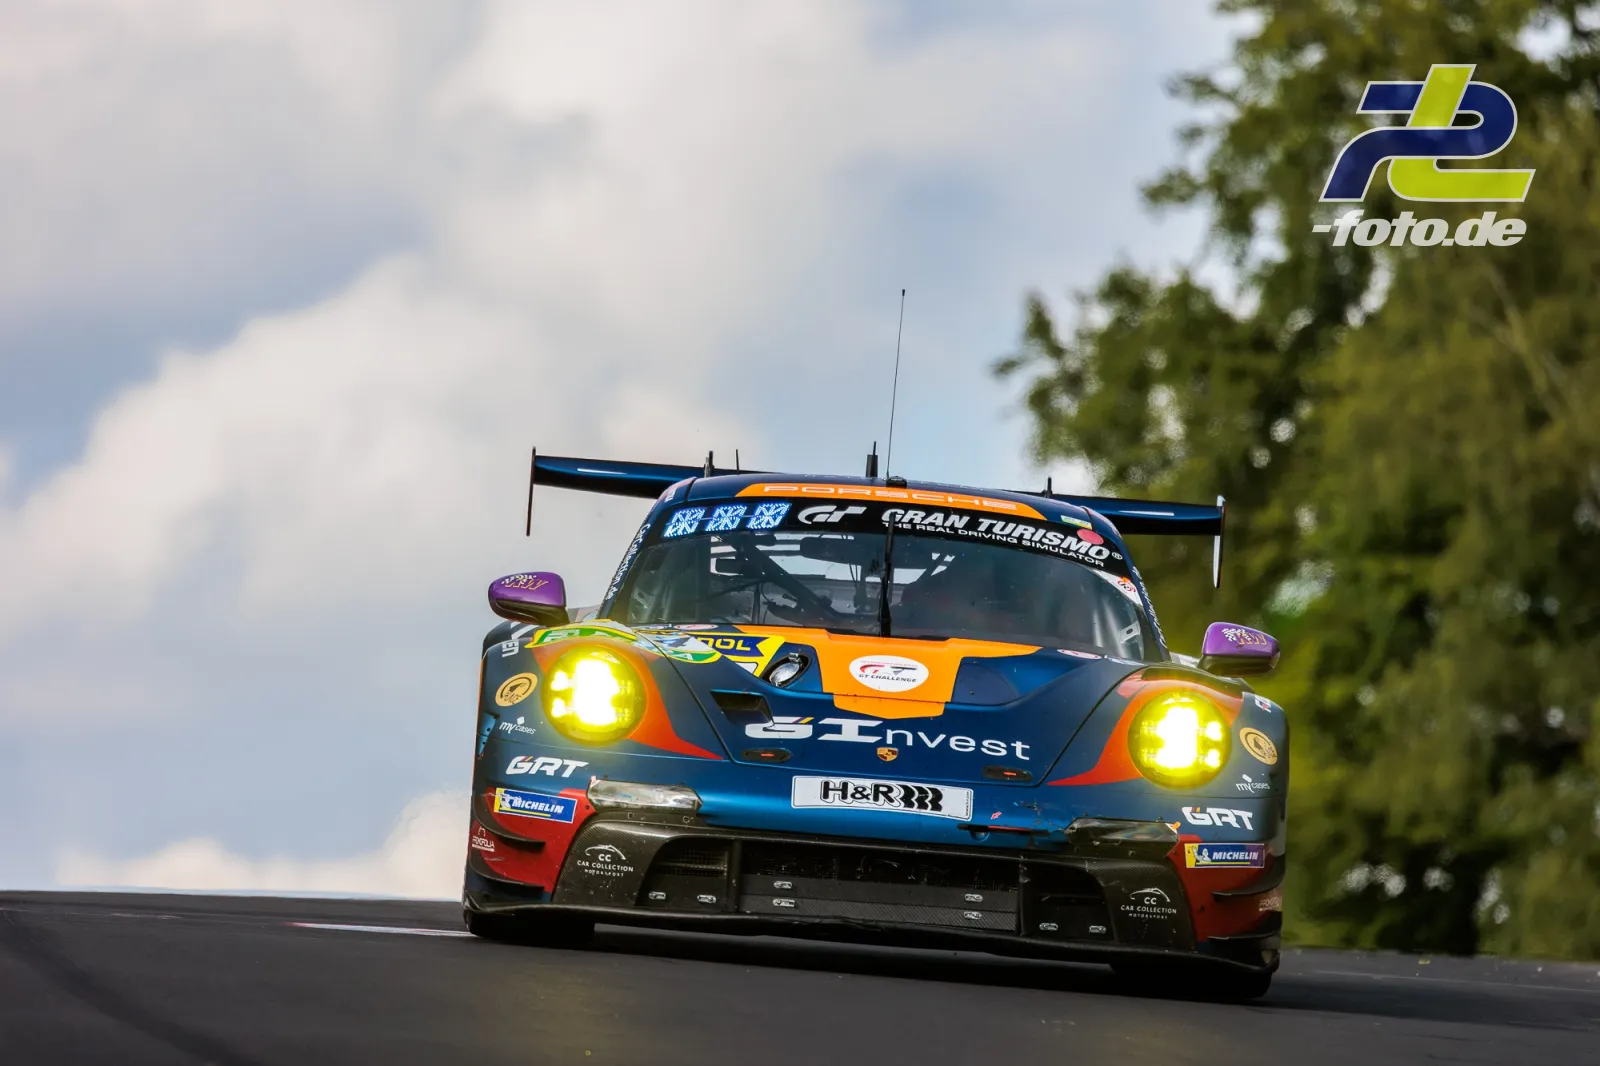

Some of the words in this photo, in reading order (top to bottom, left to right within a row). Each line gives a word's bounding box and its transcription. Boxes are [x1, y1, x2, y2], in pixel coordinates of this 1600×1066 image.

[763, 485, 1017, 511] PORSCHE
[881, 508, 970, 529] GRAN
[917, 524, 955, 534] REAL
[958, 528, 1018, 544] DRIVING
[1022, 540, 1105, 567] SIMULATOR
[870, 674, 917, 683] CHALLENGE
[505, 755, 590, 778] GRT
[821, 780, 900, 806] H&R
[511, 799, 565, 814] MICHELIN
[1181, 806, 1254, 831] GRT
[598, 853, 612, 862] CC
[1212, 851, 1259, 860] MICHELIN
[591, 862, 634, 872] COLLECTION
[1143, 896, 1157, 905] CC
[1136, 905, 1177, 914] COLLECTION
